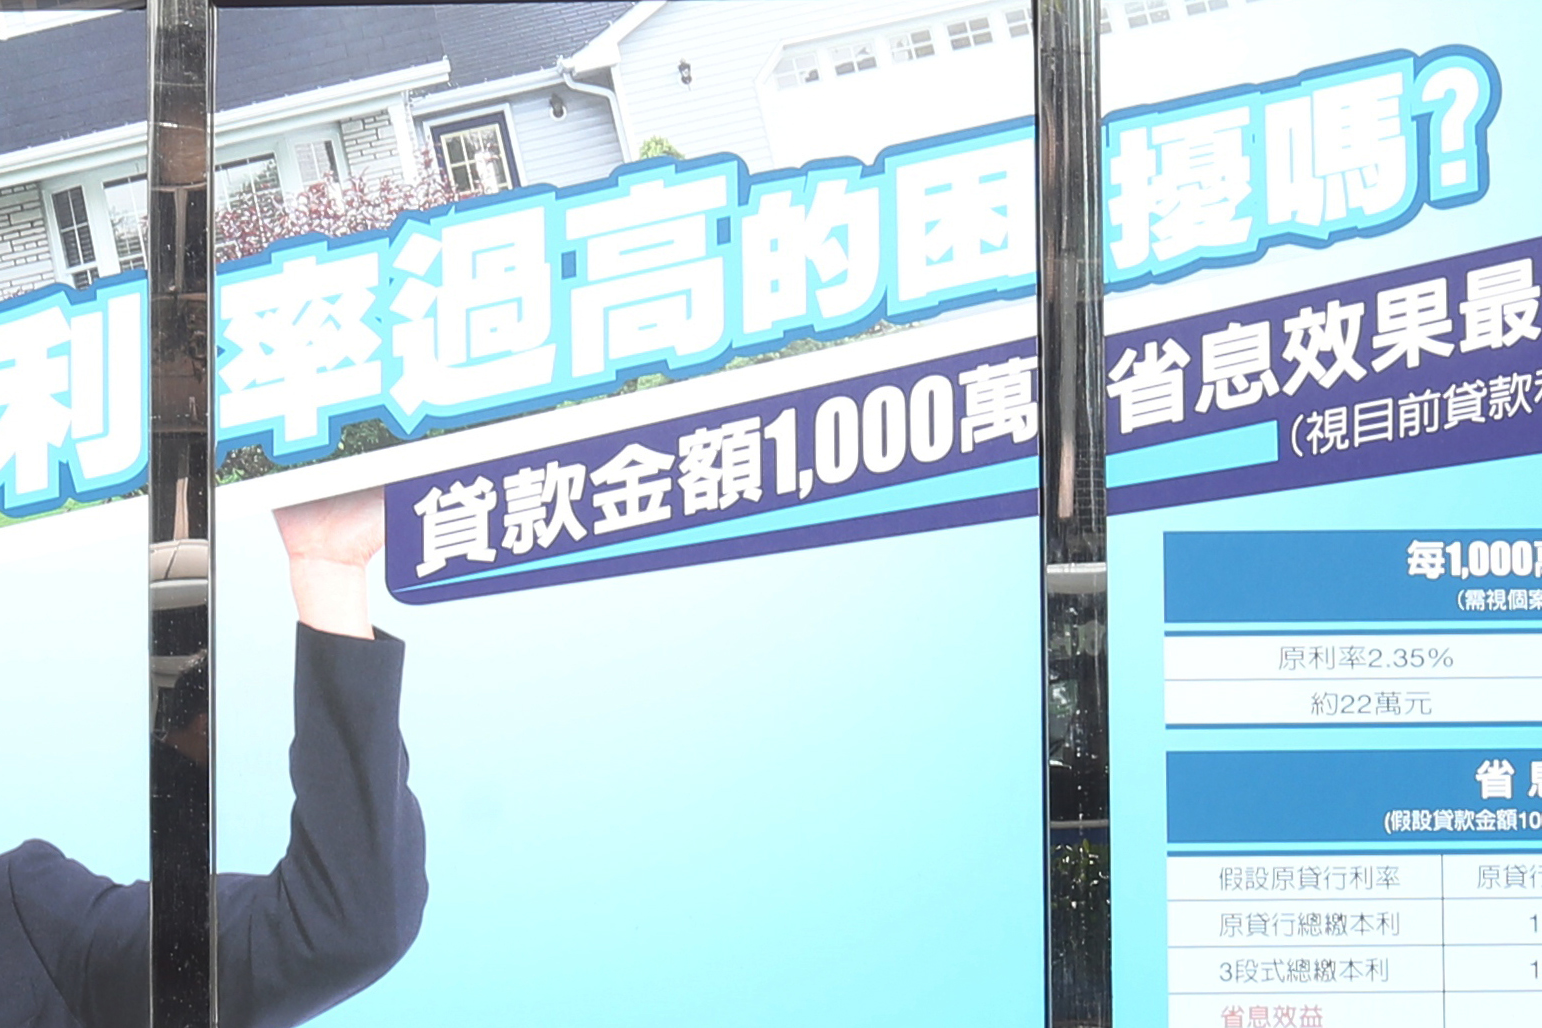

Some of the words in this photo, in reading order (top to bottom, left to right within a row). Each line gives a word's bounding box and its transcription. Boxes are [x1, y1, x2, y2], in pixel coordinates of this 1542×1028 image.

[415, 356, 1038, 577] 貸款金額1,000萬
[1105, 257, 1541, 434] 省息效果最
[1406, 540, 1542, 580] 每1,000
[1278, 645, 1454, 671] 原利率2.35%
[1310, 691, 1432, 716] 約22萬元
[1384, 808, 1542, 835] (假設貸款金額10
[1218, 866, 1401, 892] 假設原貸行利率
[1218, 912, 1400, 937] 原貸行總繳本利
[1218, 957, 1389, 983] 3段式總繳本利
